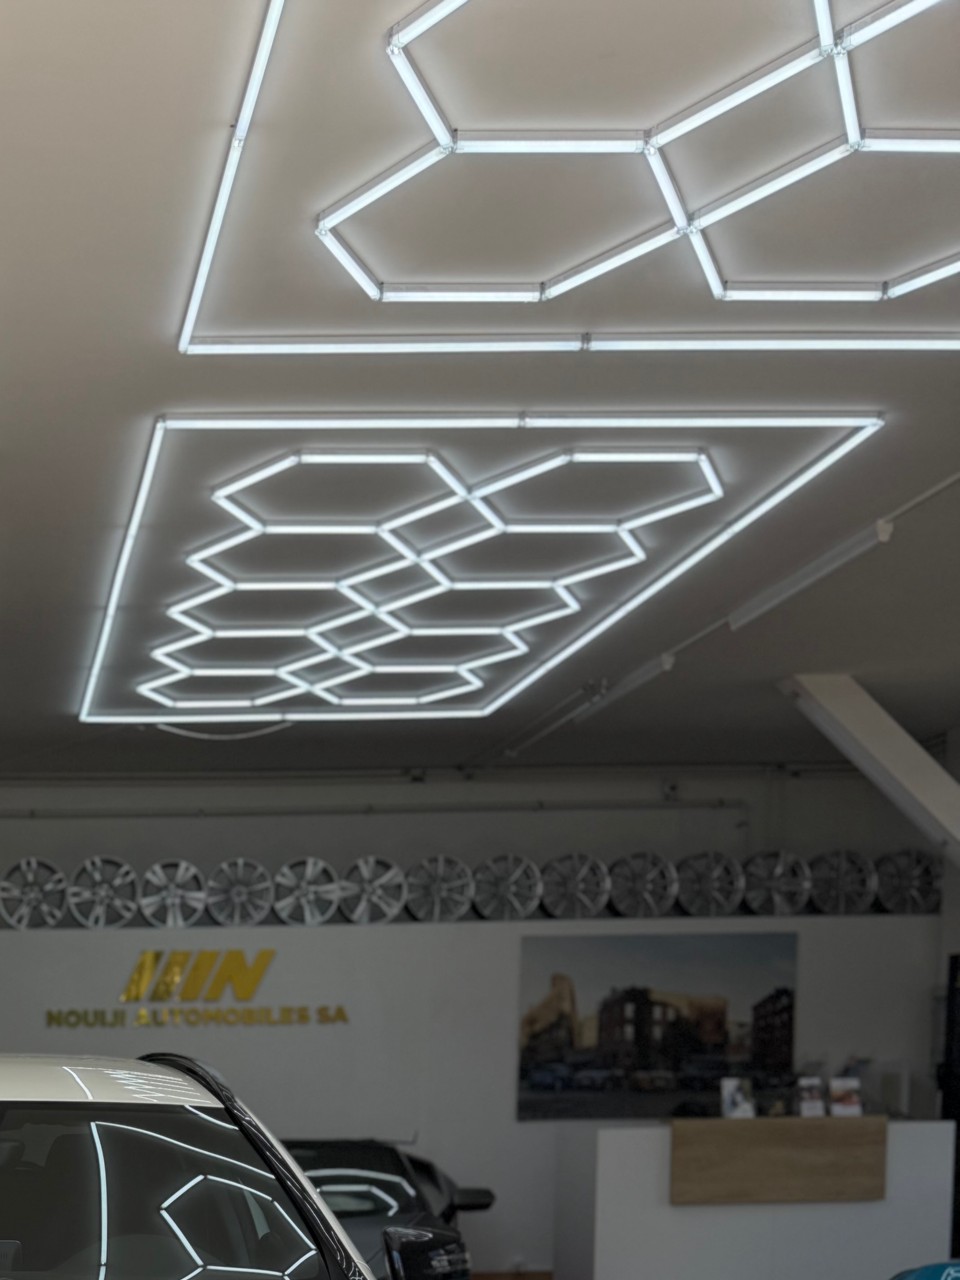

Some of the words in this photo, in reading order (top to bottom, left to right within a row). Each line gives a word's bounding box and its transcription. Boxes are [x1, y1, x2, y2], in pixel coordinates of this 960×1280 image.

[46, 1009, 126, 1028] NOUIJI
[133, 1006, 310, 1026] AUTOMOBILES
[317, 1005, 349, 1024] SA
